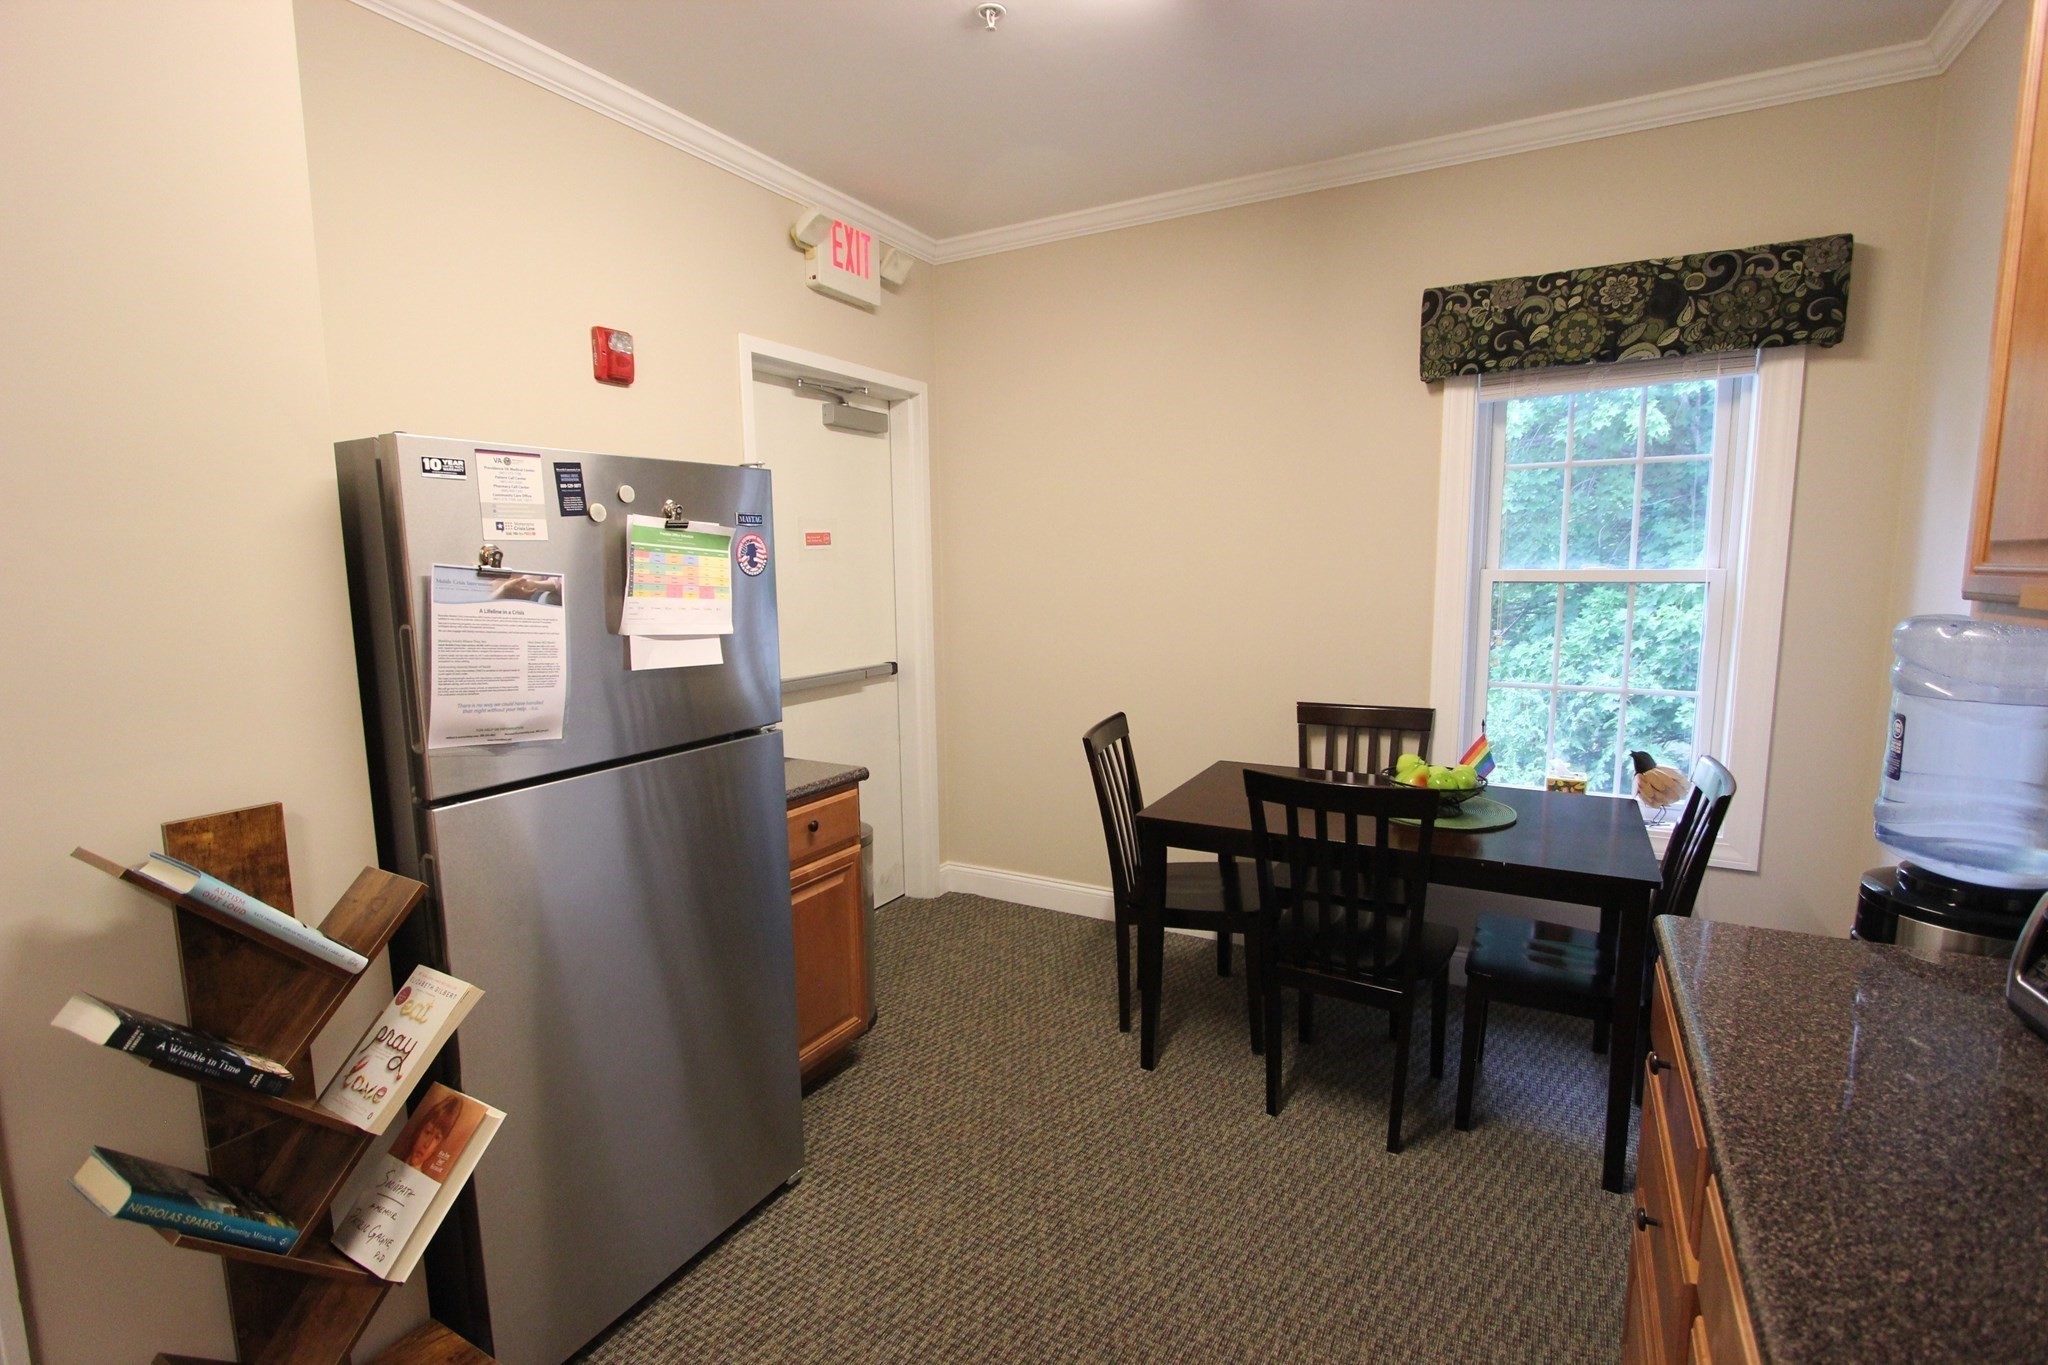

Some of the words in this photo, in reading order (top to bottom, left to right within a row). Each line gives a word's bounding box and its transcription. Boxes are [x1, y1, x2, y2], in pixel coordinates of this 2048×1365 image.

[831, 219, 871, 280] EXIT
[422, 457, 442, 471] 10
[442, 459, 464, 467] YEAR
[738, 515, 763, 523] MAYTAG
[201, 890, 222, 906] OUT
[222, 900, 247, 917] LOUD
[213, 887, 246, 906] AUTISM
[410, 976, 435, 990] ELIZABETH
[433, 986, 458, 1000] GILBERT
[399, 999, 436, 1025] eat
[156, 1041, 167, 1051] A
[169, 1043, 207, 1064] Wrinkle
[206, 1058, 218, 1067] in
[218, 1058, 242, 1075] Time
[361, 1025, 419, 1081] pray
[342, 1054, 388, 1104] love
[127, 1202, 184, 1224] NICHOLAS
[182, 1213, 222, 1232] SPARKS
[374, 1205, 398, 1221] MEMOIR
[222, 1225, 252, 1239] Counting
[252, 1231, 277, 1244] Miracles
